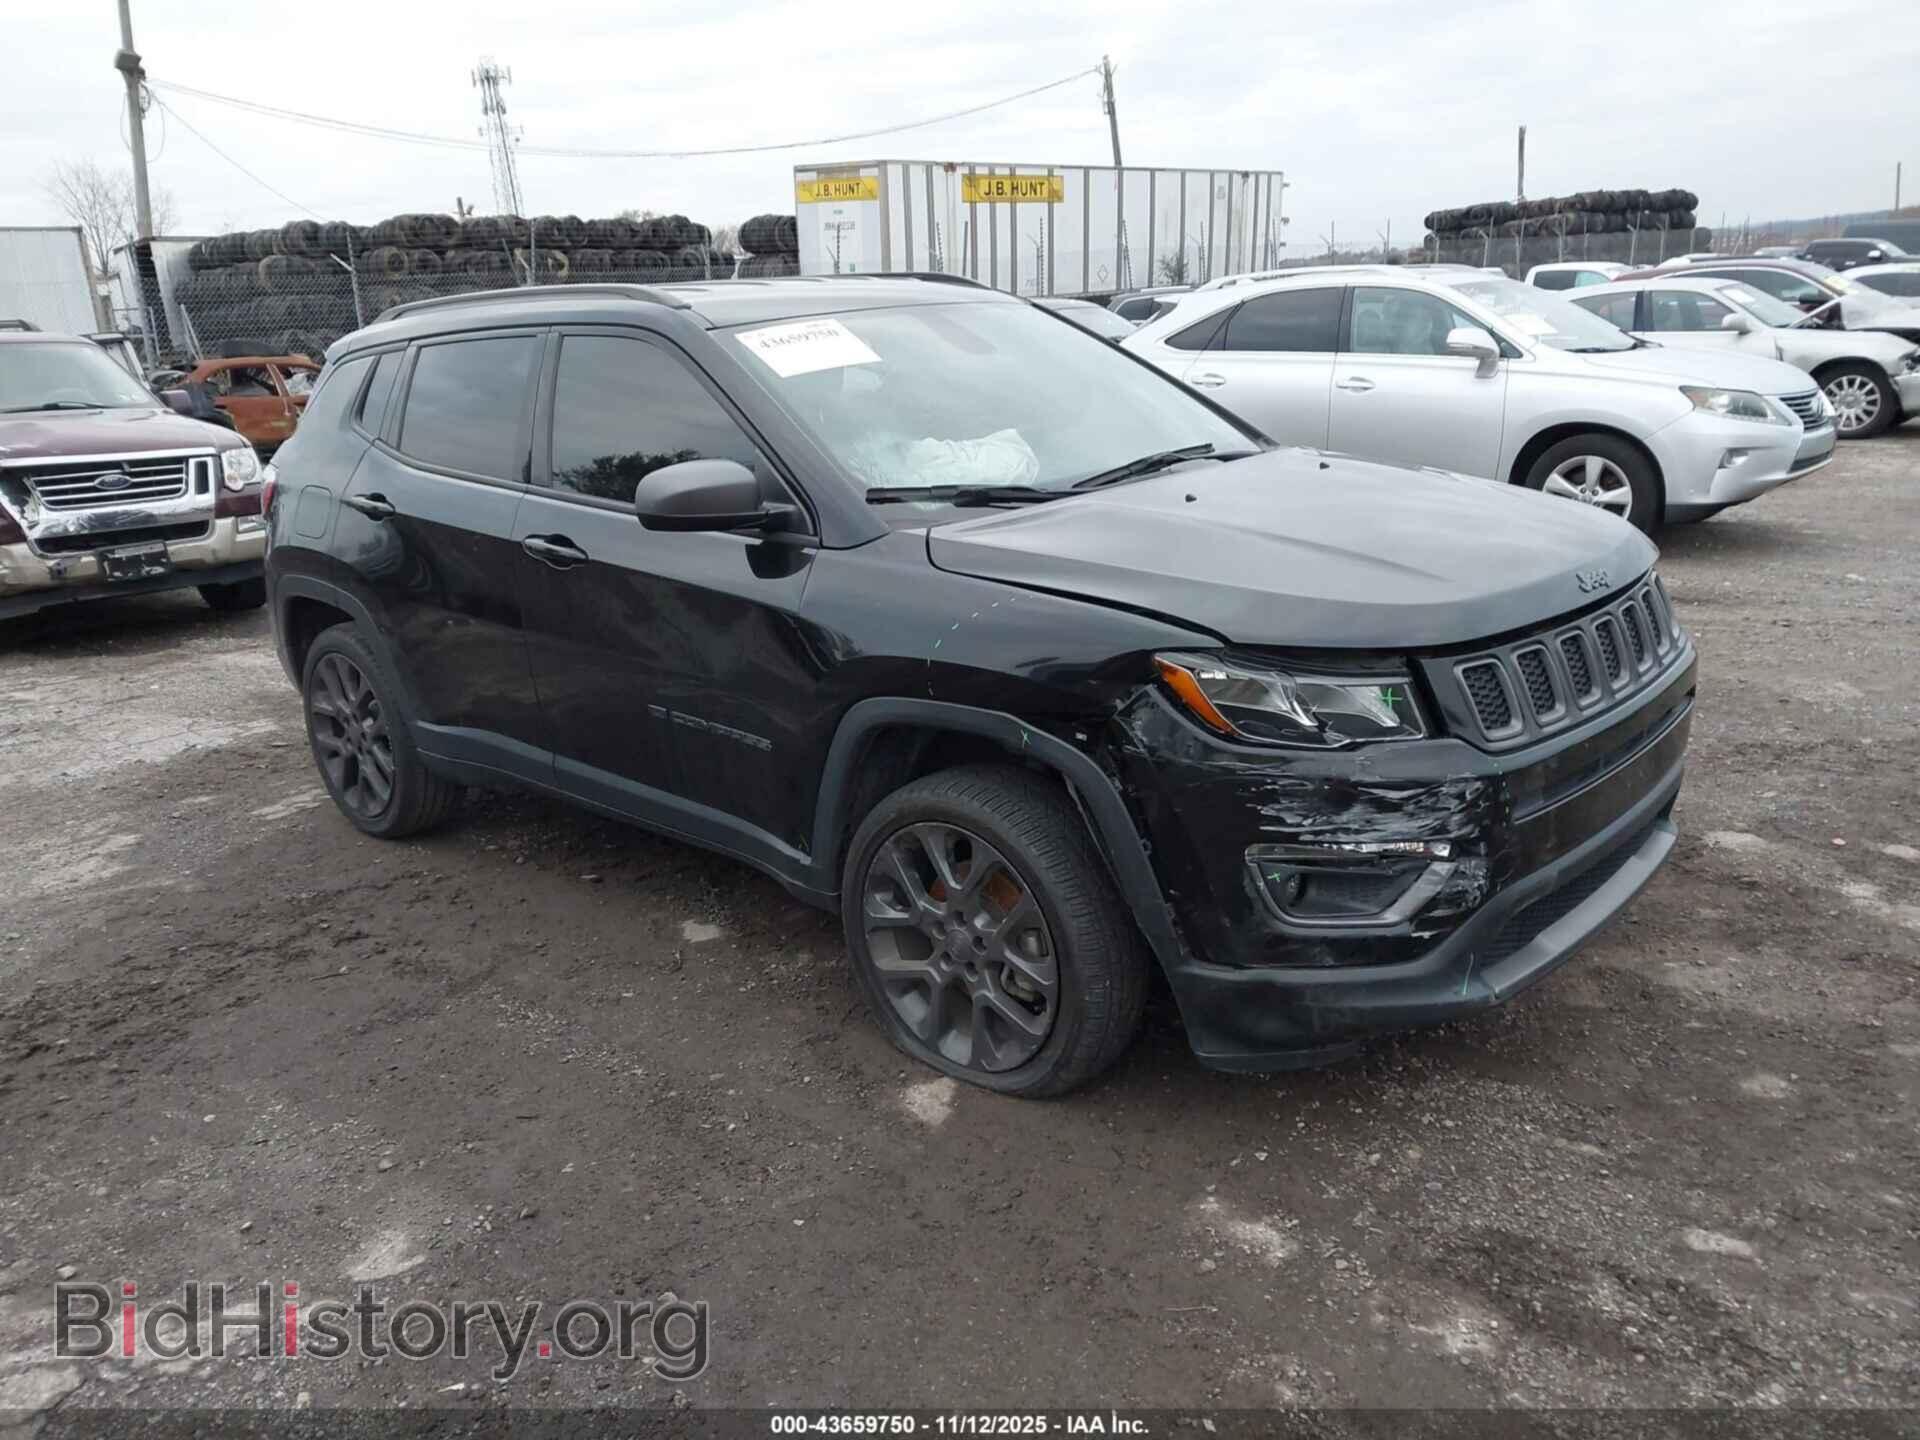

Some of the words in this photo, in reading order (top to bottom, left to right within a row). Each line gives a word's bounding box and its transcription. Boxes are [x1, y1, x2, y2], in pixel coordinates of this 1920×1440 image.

[816, 183, 833, 197] J.B.
[834, 182, 860, 196] HUNT
[984, 181, 1007, 196] J.B.
[1010, 181, 1045, 196] HUNT
